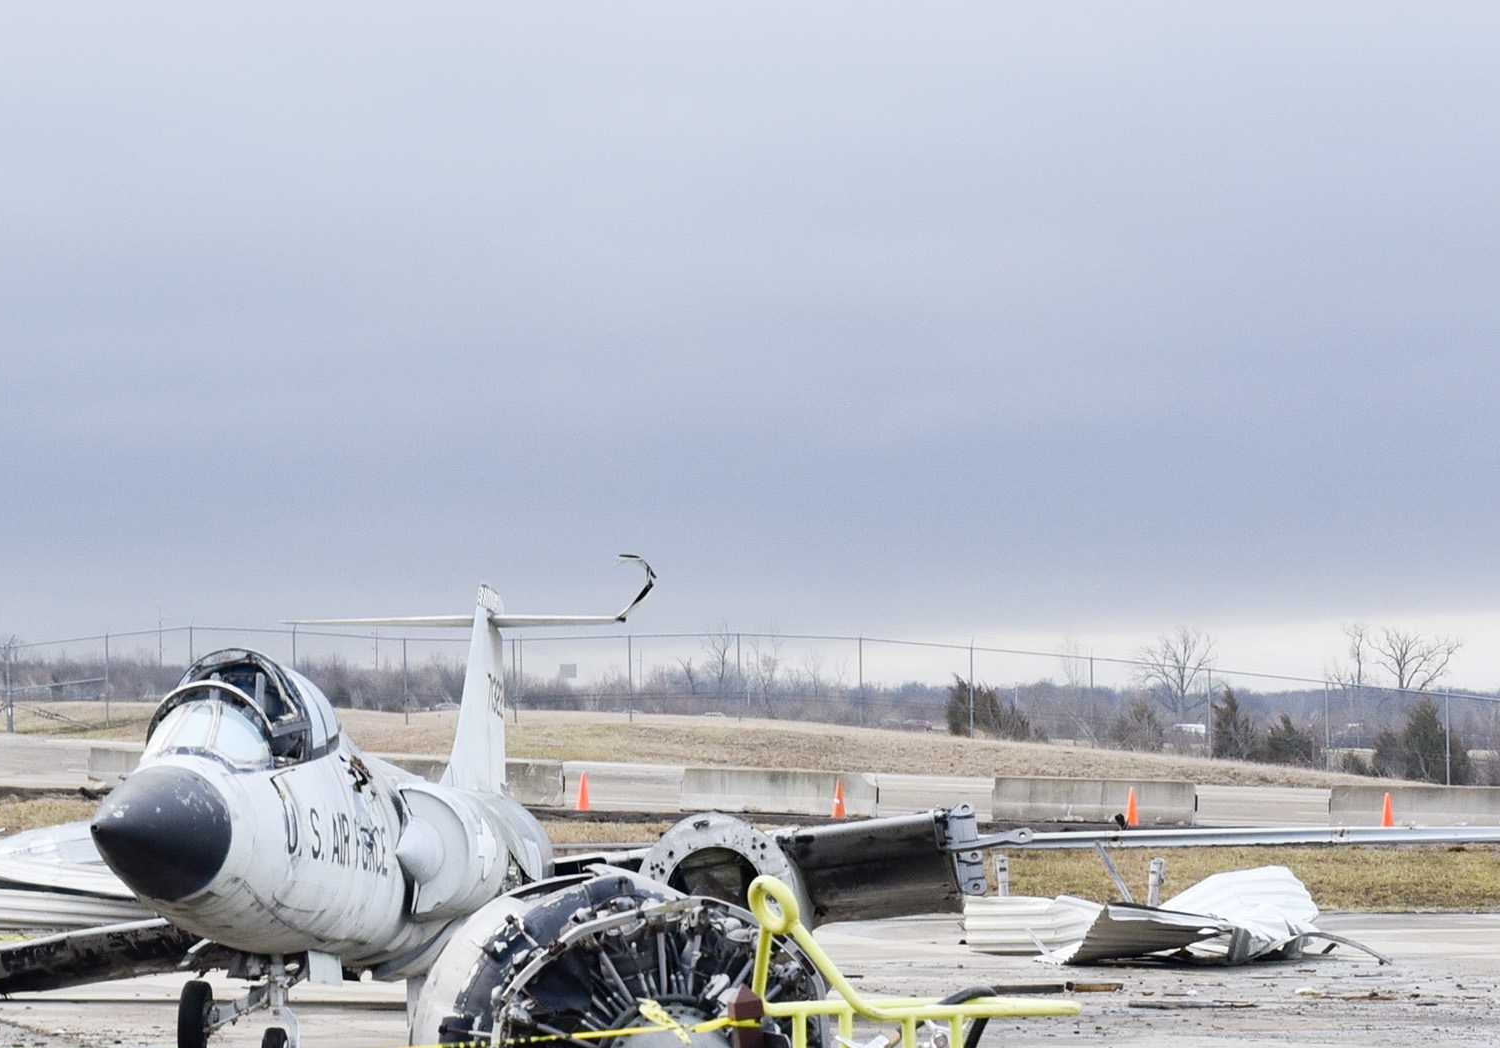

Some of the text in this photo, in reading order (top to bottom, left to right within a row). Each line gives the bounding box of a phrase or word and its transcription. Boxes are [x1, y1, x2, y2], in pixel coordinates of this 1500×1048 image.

[283, 801, 388, 876] U. S. AIR FORCE
